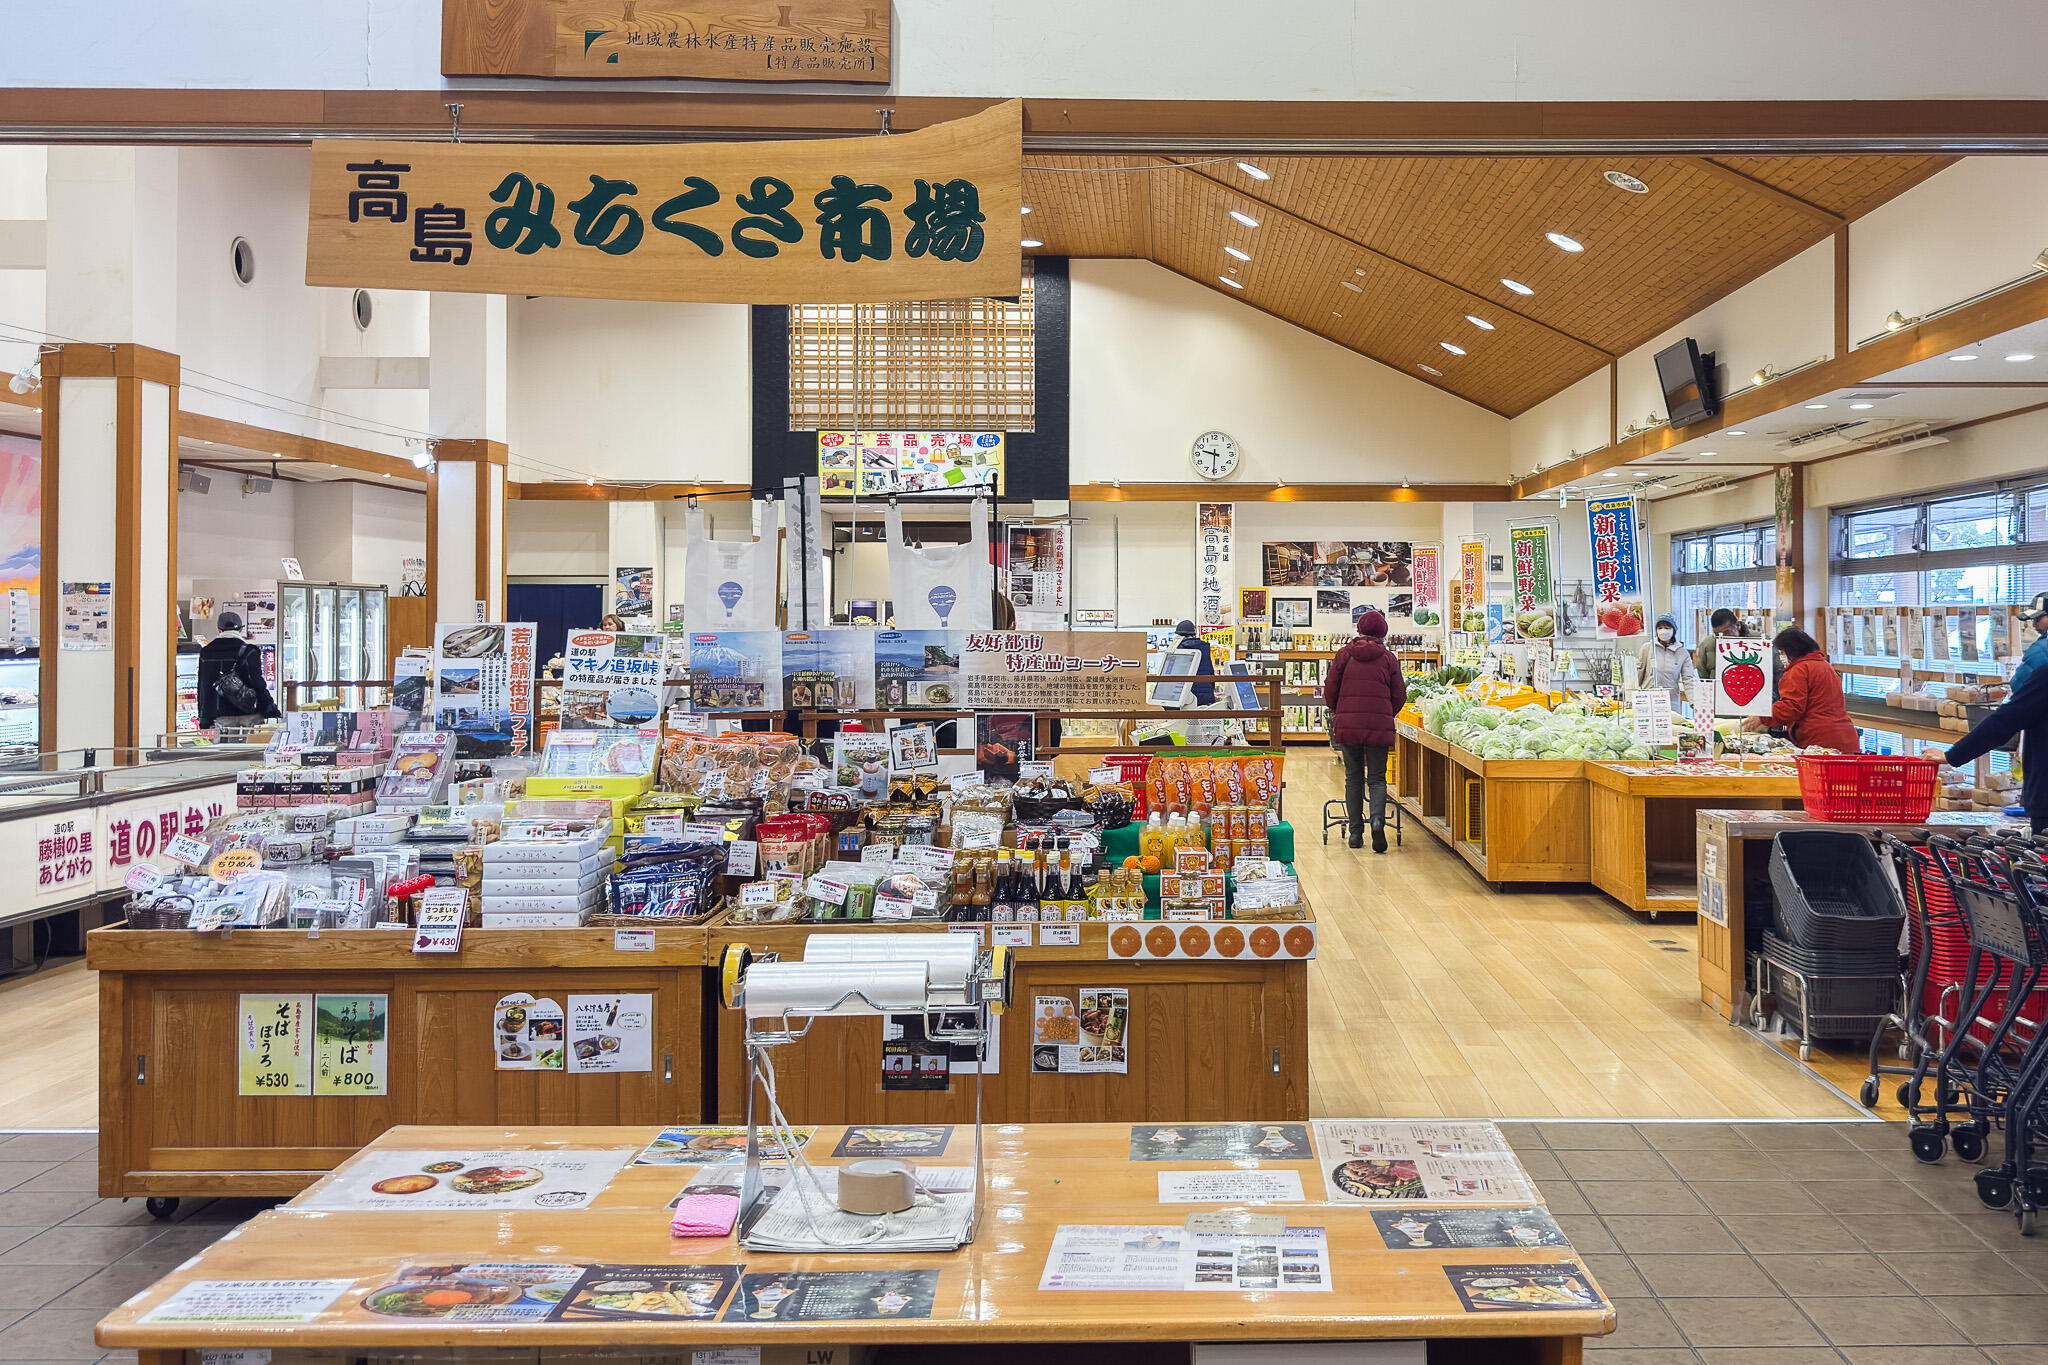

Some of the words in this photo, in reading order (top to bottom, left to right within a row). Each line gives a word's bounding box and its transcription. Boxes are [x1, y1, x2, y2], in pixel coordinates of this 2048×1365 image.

[626, 31, 874, 54] 地域農林水産特産品販売施設
[849, 433, 974, 448] 工芸品売場
[1594, 512, 1621, 603] 新鮮野菜
[1619, 512, 1634, 593] とれたて、おいしい
[1056, 530, 1064, 607] 今年の新酒ができました
[1203, 525, 1221, 613] 高島の地酒
[1515, 540, 1536, 612] 新鮮野菜
[1415, 556, 1428, 608] 新鮮野菜
[1464, 551, 1475, 611] 新鮮野菜
[571, 648, 596, 657] 道の駅
[966, 633, 1044, 653] 友好都市
[1718, 641, 1772, 653] いちご
[569, 657, 659, 675] マキノ追坂峠
[1006, 654, 1141, 673] 特産品コーナー
[510, 627, 532, 757] 若狭鯖街道フェア
[570, 674, 657, 686] の特産品が届きました
[1201, 779, 1214, 803] もち
[1256, 777, 1269, 801] もち
[53, 820, 75, 833] 道の駅
[39, 831, 93, 862] 藤樹の里
[39, 856, 93, 885] あどがわ
[217, 860, 256, 868] ちりめん
[275, 1002, 291, 1037] そば
[339, 1024, 360, 1065] そば
[255, 1072, 289, 1088] ¥530
[333, 1072, 375, 1087] ¥800
[806, 1350, 834, 1365] LW
